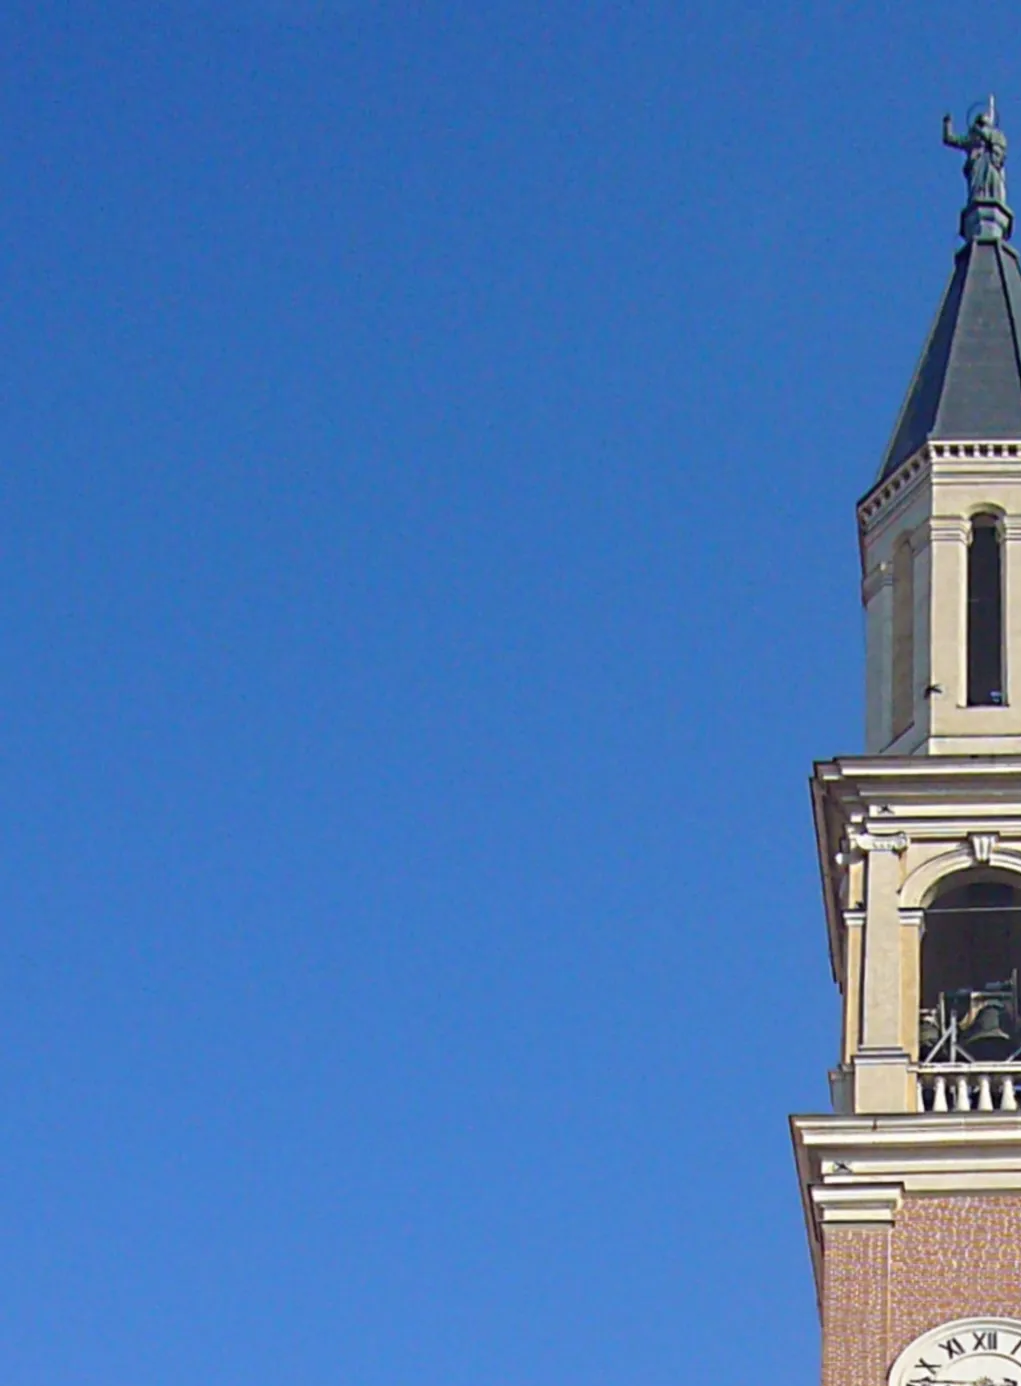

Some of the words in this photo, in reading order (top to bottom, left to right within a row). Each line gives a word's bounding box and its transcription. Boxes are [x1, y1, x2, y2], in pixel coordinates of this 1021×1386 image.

[938, 1337, 966, 1360] XI
[973, 1331, 998, 1351] XII
[914, 1357, 942, 1375] X
